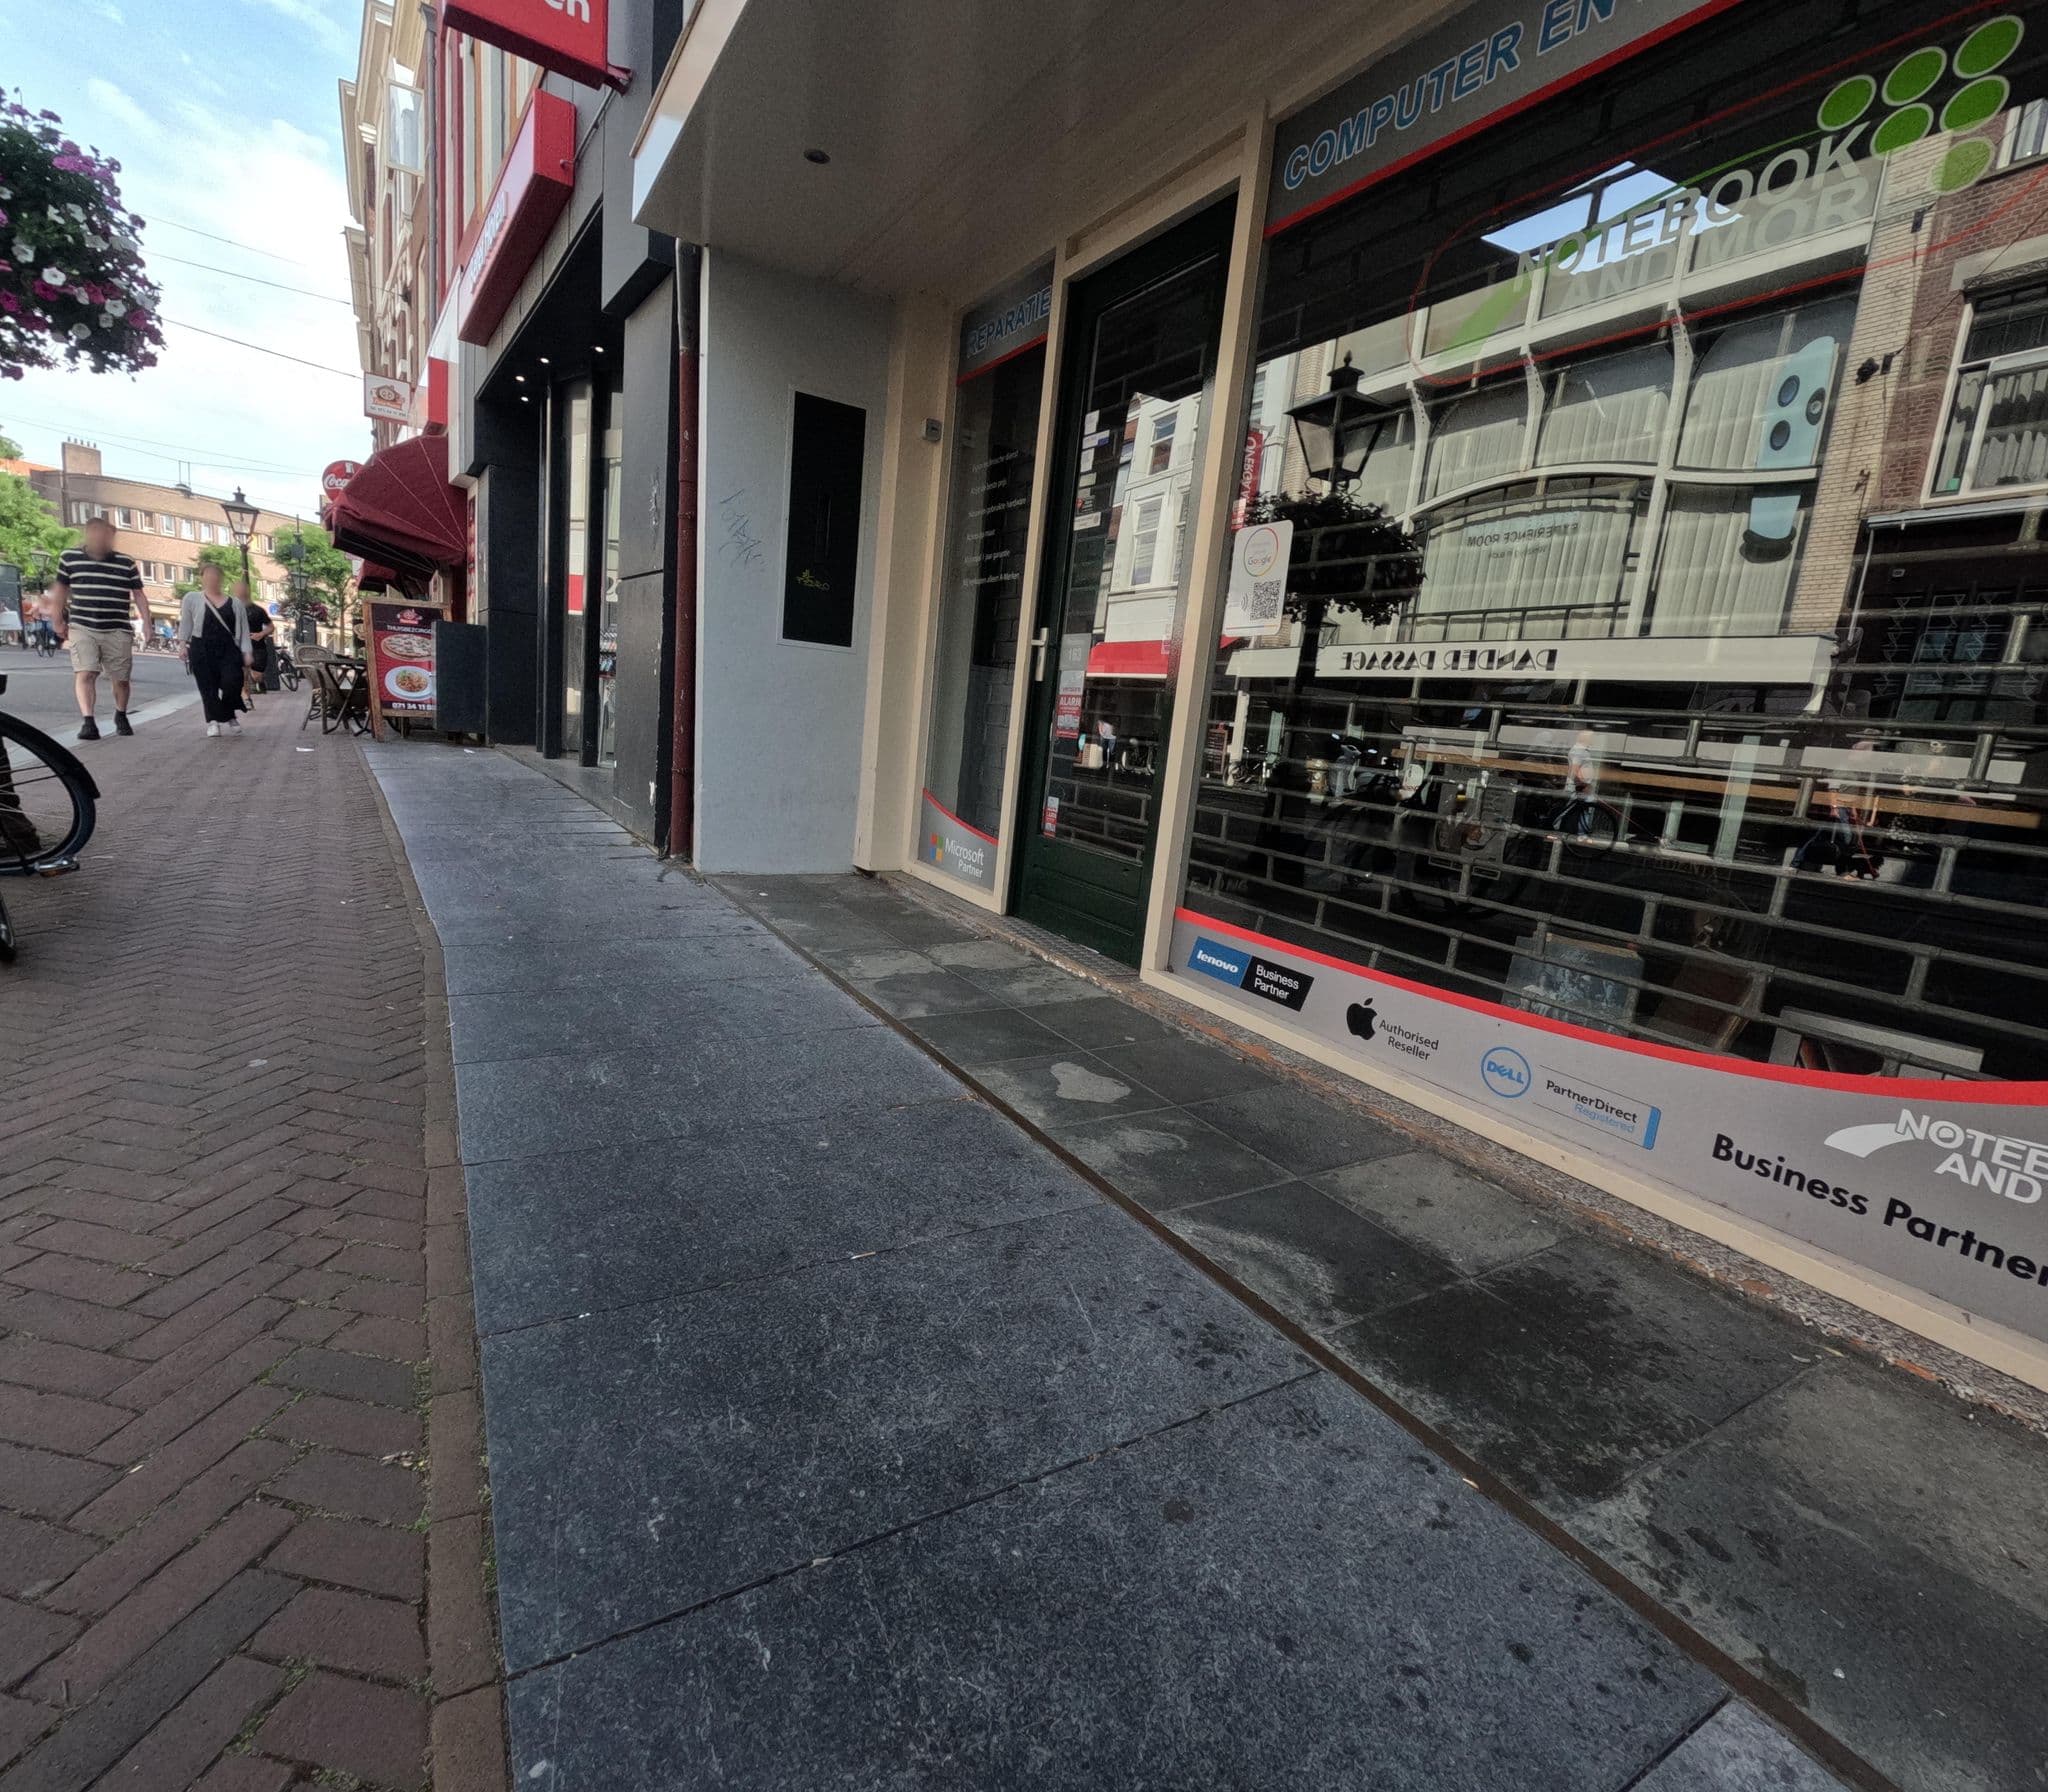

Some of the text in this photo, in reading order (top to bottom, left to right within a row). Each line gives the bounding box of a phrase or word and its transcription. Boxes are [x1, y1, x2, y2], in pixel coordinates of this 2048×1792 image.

[1283, 21, 1523, 190] COMPUTER
[1513, 121, 1870, 293] NOTEBOOK
[967, 285, 1052, 358] REPARATIE
[945, 838, 984, 866] Microsoft
[958, 859, 983, 878] Partner
[1196, 949, 1239, 974] lenovo
[1255, 964, 1300, 990] Business
[1254, 978, 1290, 1000] Partner
[1378, 1019, 1440, 1051] Authorised
[1387, 1036, 1431, 1061] Reseller
[1486, 1060, 1524, 1085] DELL
[1546, 1079, 1638, 1124] PartnerDirect
[1574, 1103, 1636, 1133] Registered
[1895, 1108, 2048, 1180] NOTEB
[1712, 1133, 1869, 1215] Business
[1934, 1151, 2043, 1204] AND
